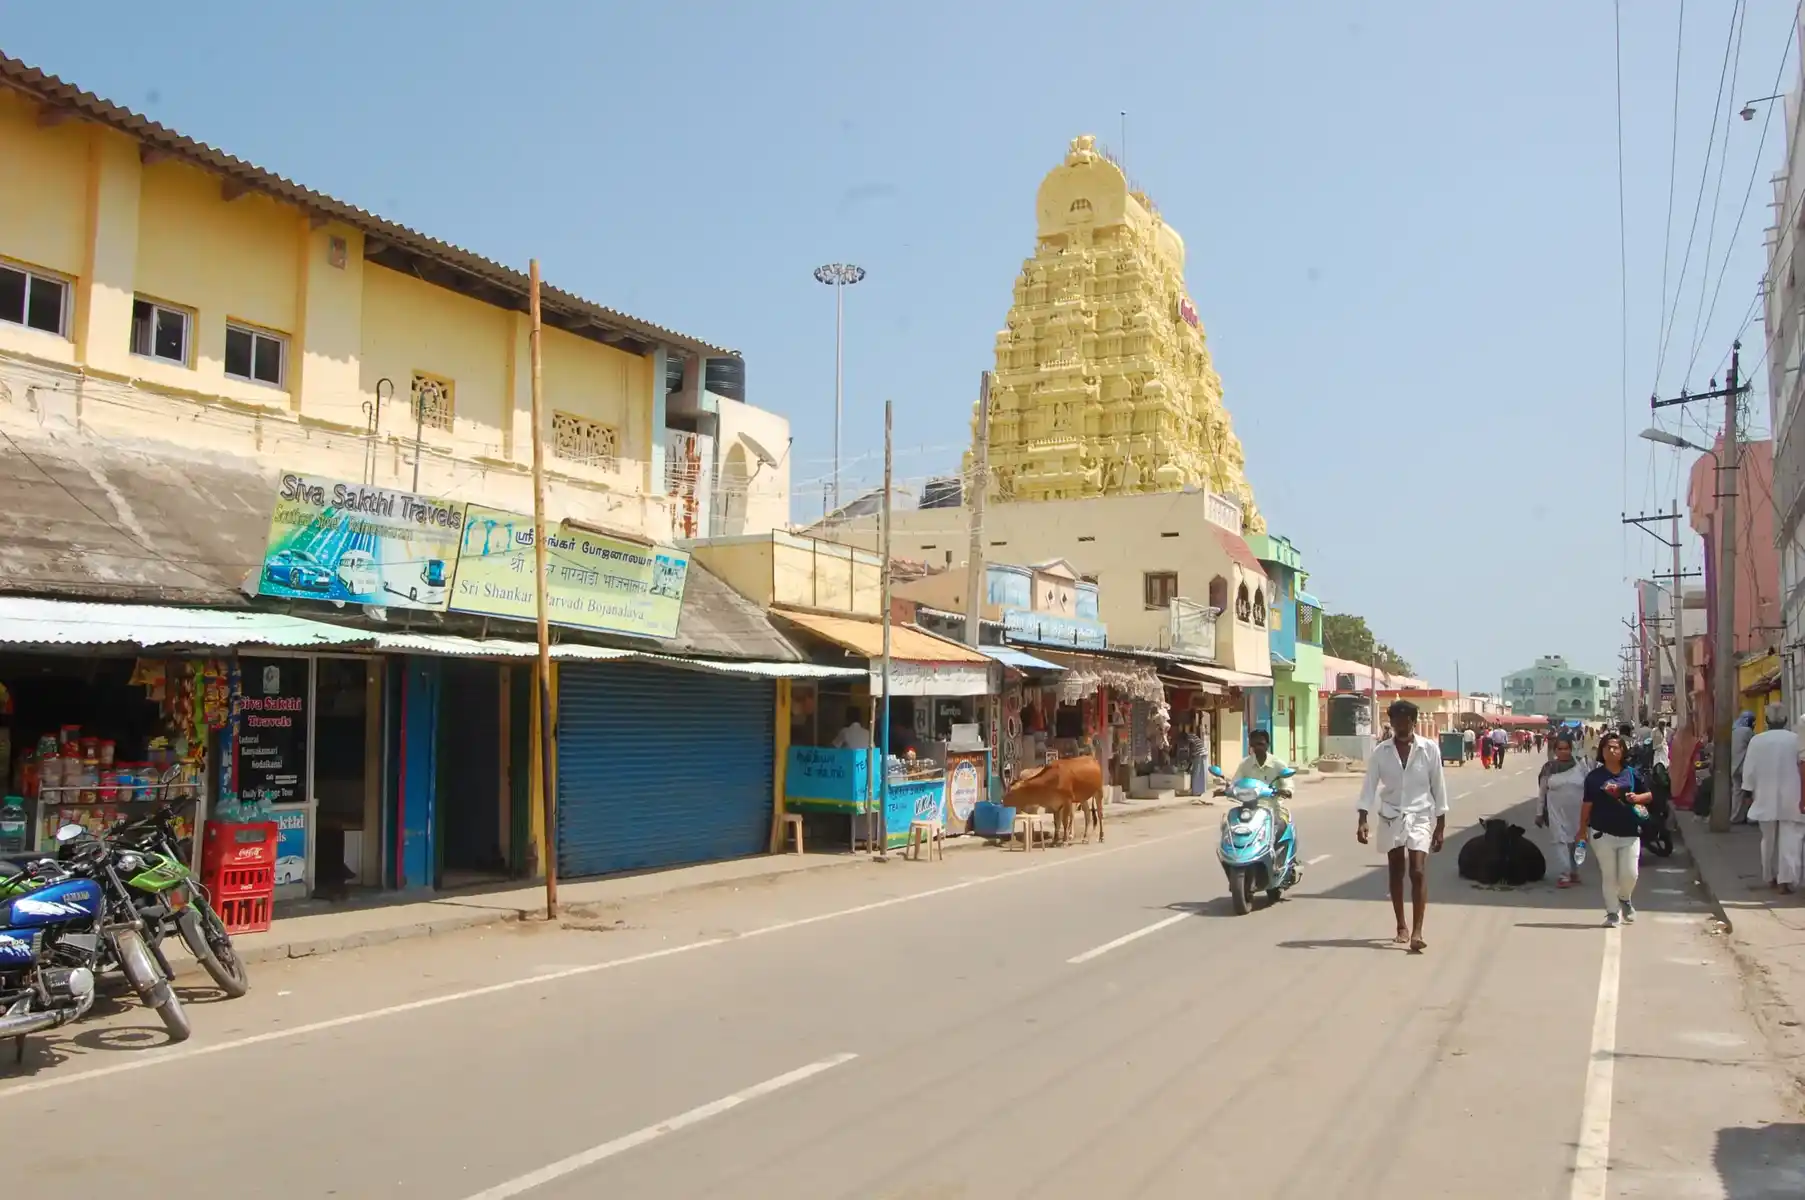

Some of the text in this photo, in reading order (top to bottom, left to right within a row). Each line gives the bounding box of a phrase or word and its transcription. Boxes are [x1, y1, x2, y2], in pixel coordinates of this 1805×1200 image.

[279, 474, 462, 529] Siva Sakthi Travels
[546, 533, 576, 552] ங்கர்
[460, 580, 645, 622] Sri Shankar arvadi Bojanalaya
